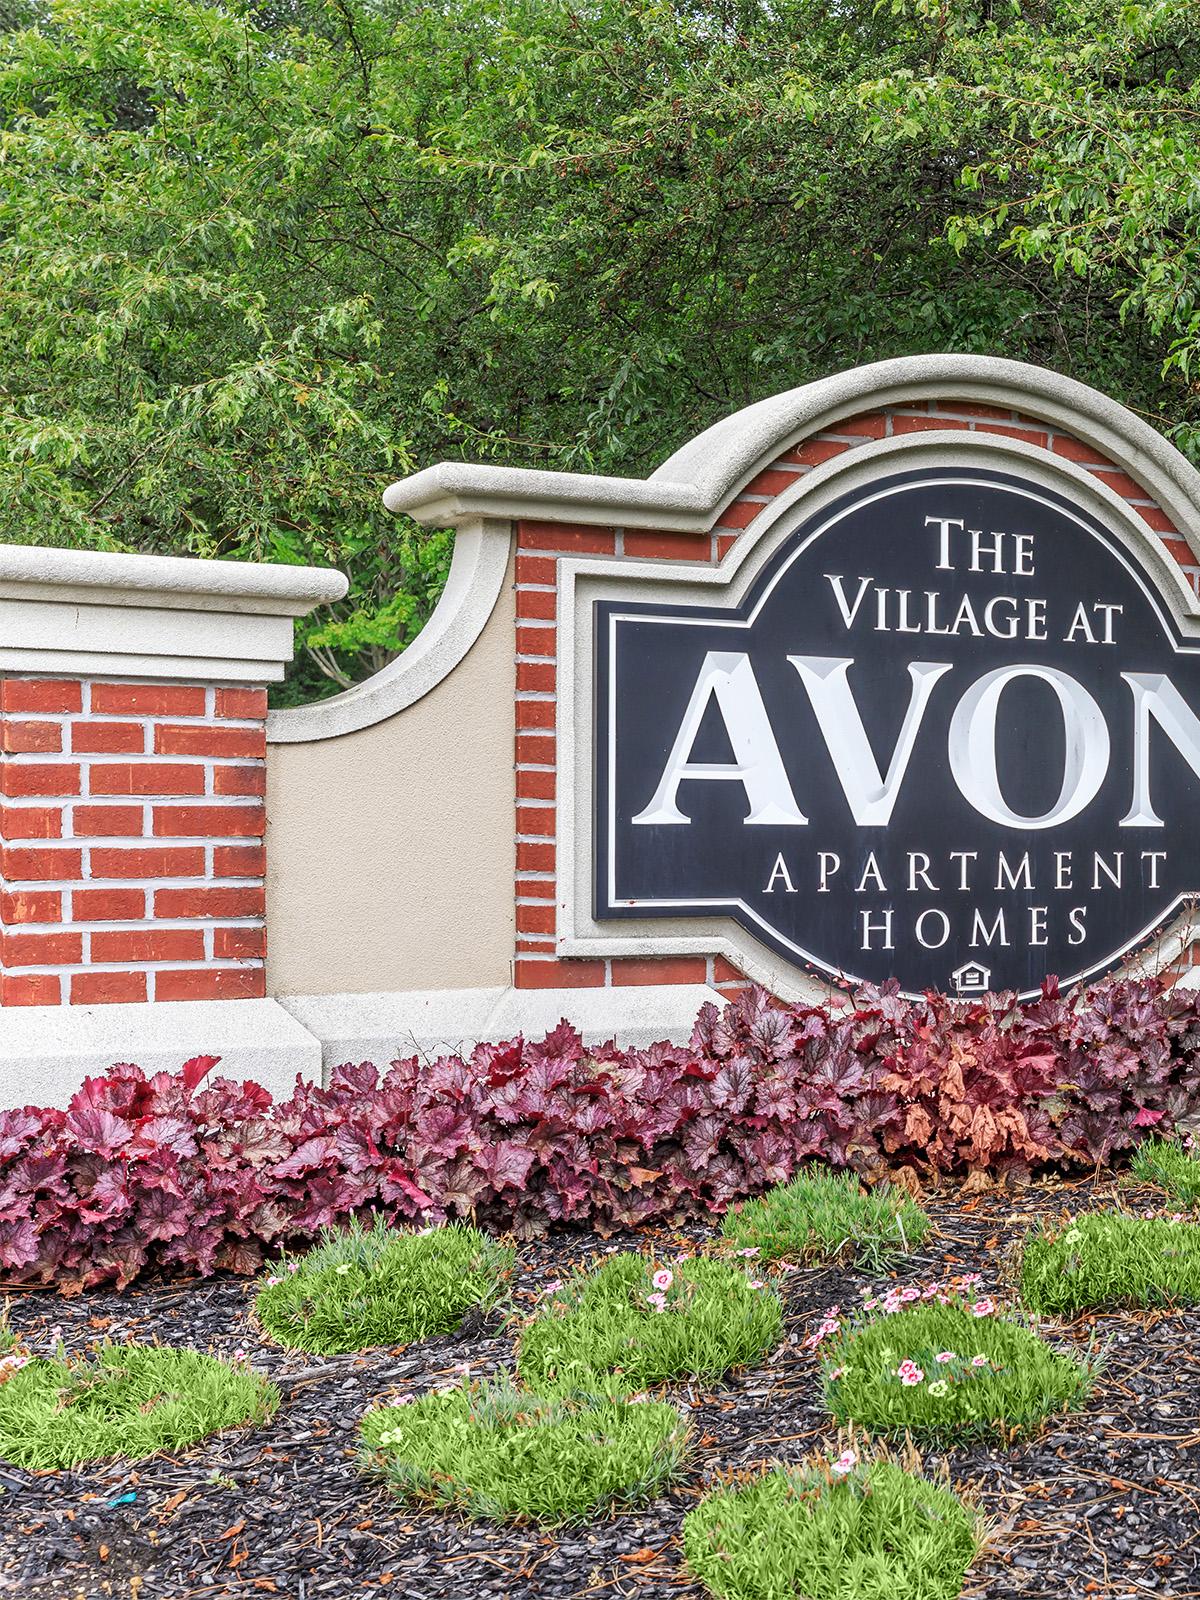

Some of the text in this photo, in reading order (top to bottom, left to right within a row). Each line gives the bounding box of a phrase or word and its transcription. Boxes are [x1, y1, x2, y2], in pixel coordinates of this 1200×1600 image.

[1062, 602, 1124, 646] AT
[761, 850, 1168, 893] APARTMENT
[859, 905, 1088, 951] HOMES
